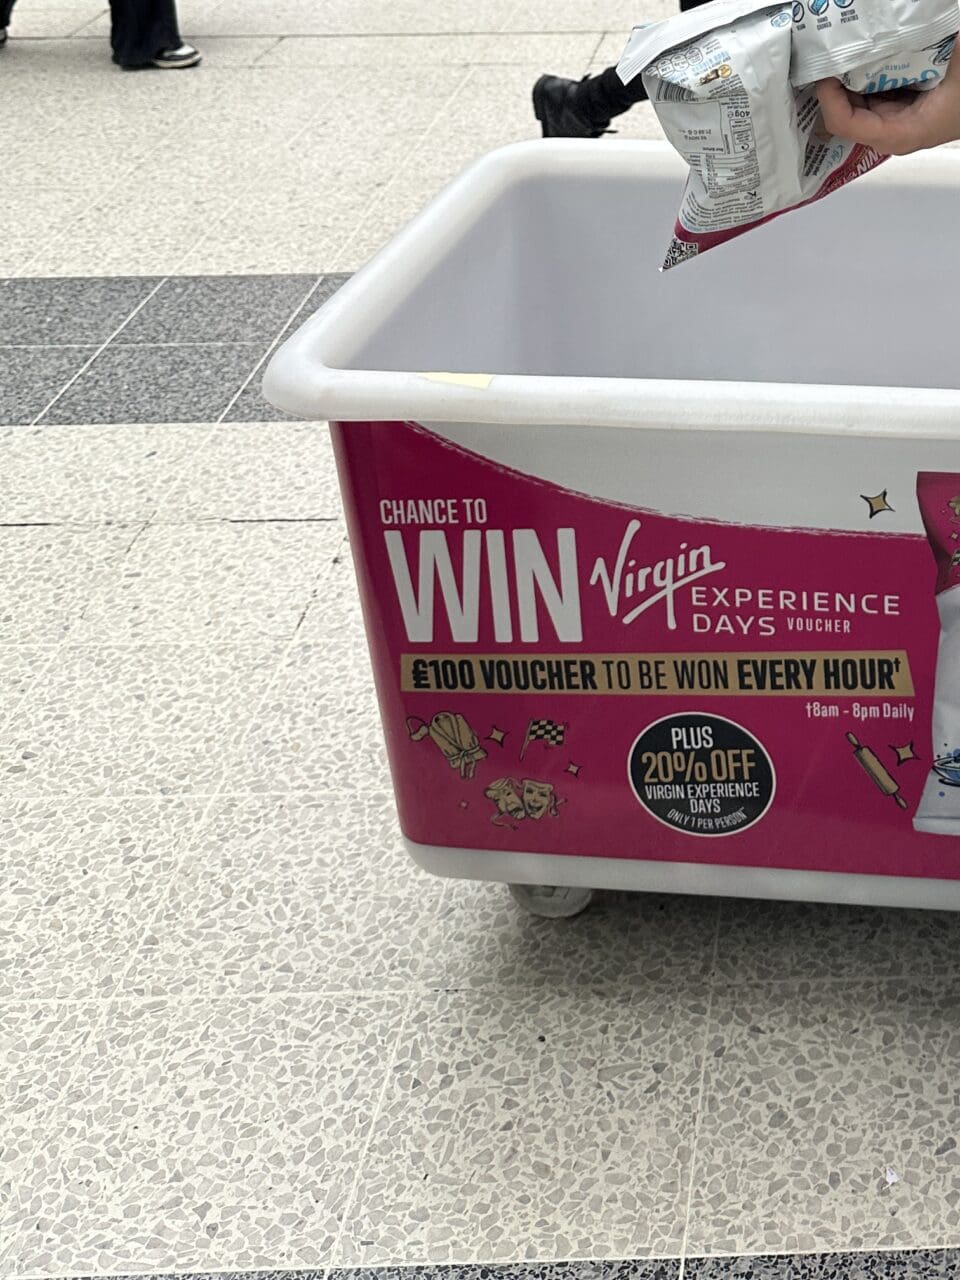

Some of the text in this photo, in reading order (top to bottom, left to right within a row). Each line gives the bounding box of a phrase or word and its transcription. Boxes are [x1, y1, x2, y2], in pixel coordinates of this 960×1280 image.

[379, 497, 488, 524] CHANCE TO
[384, 519, 726, 643] WIN Virgin
[691, 586, 900, 616] EXPERIENCE
[692, 612, 852, 637] DAYS VOUCHER
[412, 657, 475, 690] £100
[481, 658, 597, 691] VOUCHER
[602, 659, 631, 690] TO
[638, 659, 667, 690] BE
[676, 659, 728, 690] WON
[738, 658, 816, 691] EVERY
[852, 702, 880, 722] 8pm
[882, 702, 915, 722] Daily
[671, 725, 714, 749] PLUS
[641, 748, 756, 784] 20% OFF
[644, 782, 760, 800] VIRGIN EXPERIENCE
[690, 798, 721, 814] DAYS
[667, 808, 690, 826] ONLY
[690, 817, 696, 828] 1
[697, 817, 714, 830] PER
